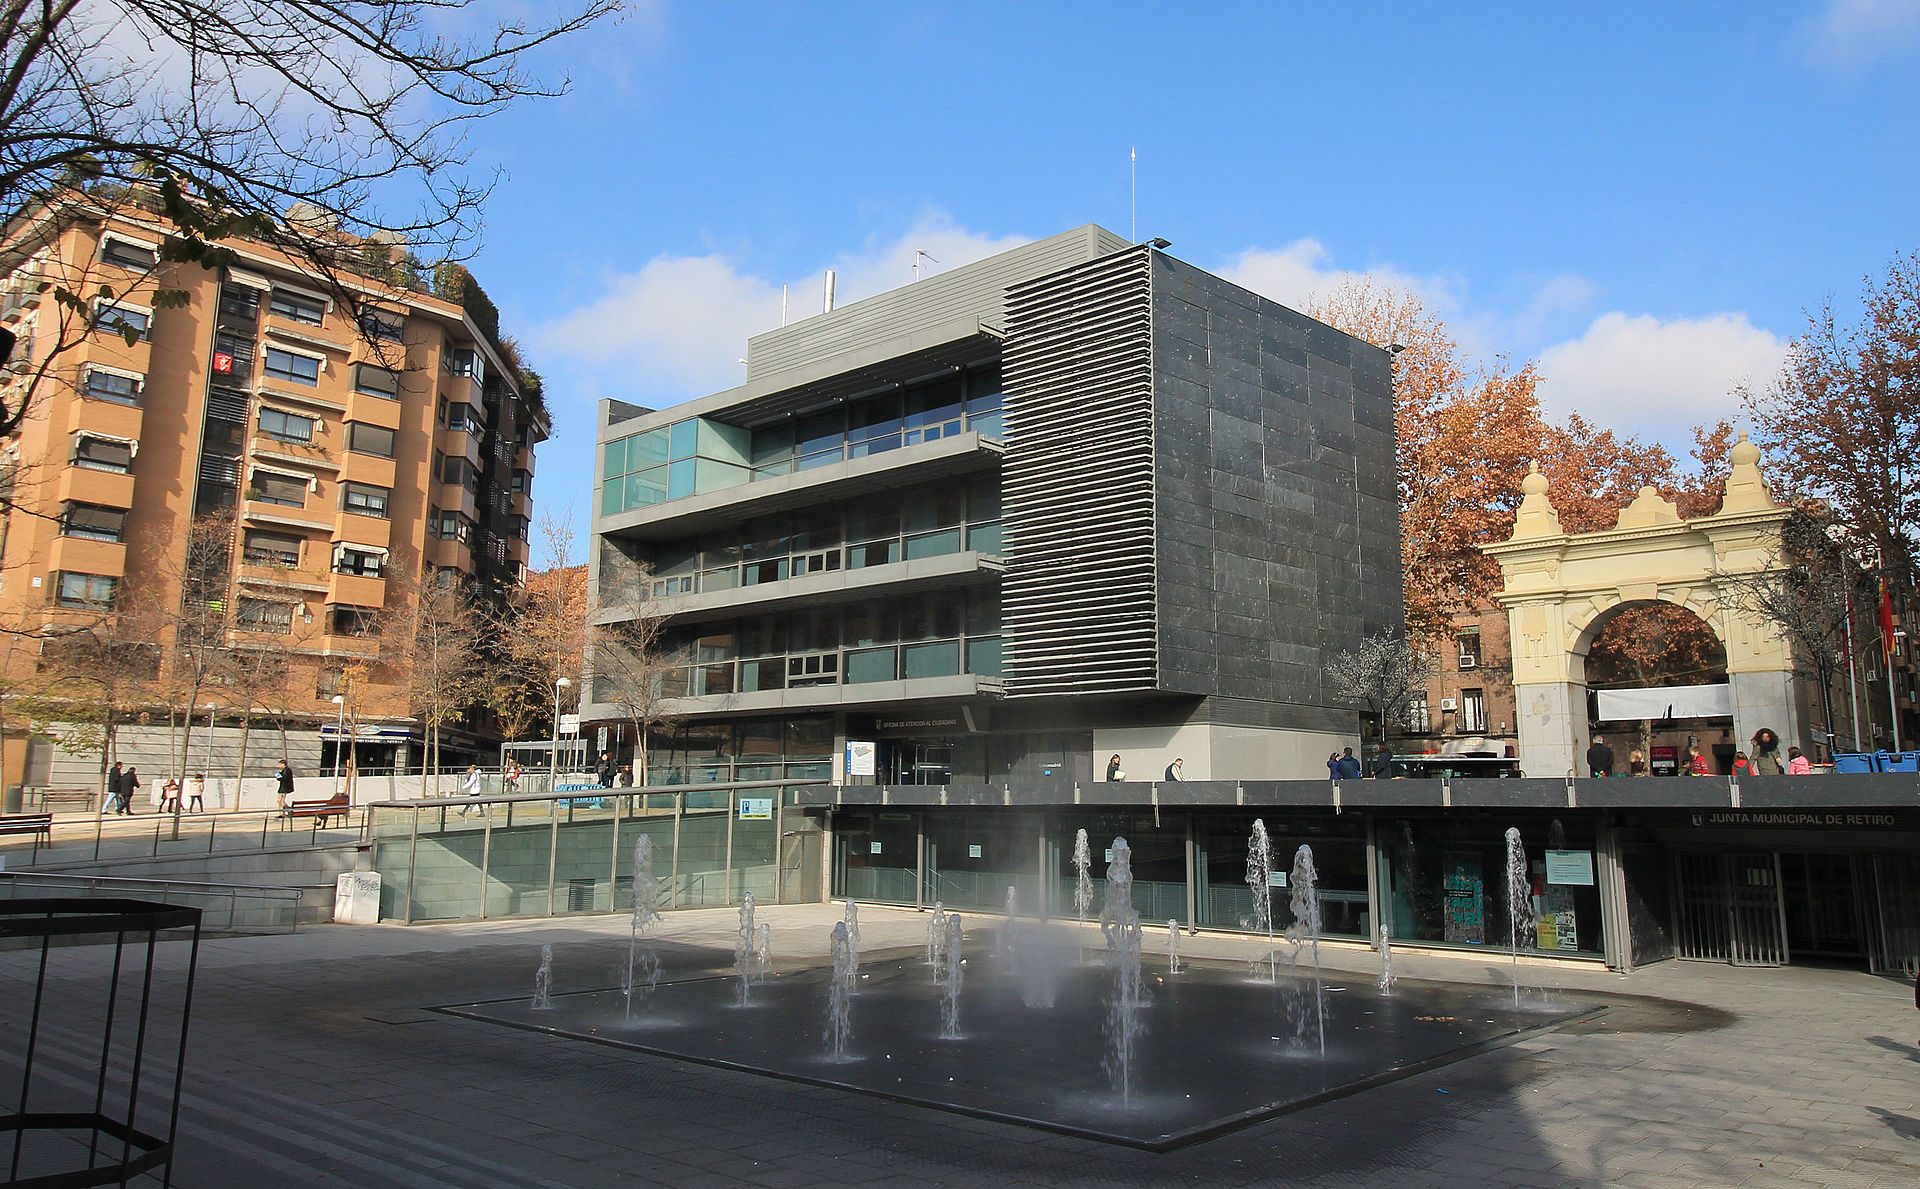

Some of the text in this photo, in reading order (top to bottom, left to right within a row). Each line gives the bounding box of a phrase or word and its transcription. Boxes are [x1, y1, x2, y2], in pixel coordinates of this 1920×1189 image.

[1710, 813, 1895, 825] JUNTA MUNICIPAL DE RETIRO
